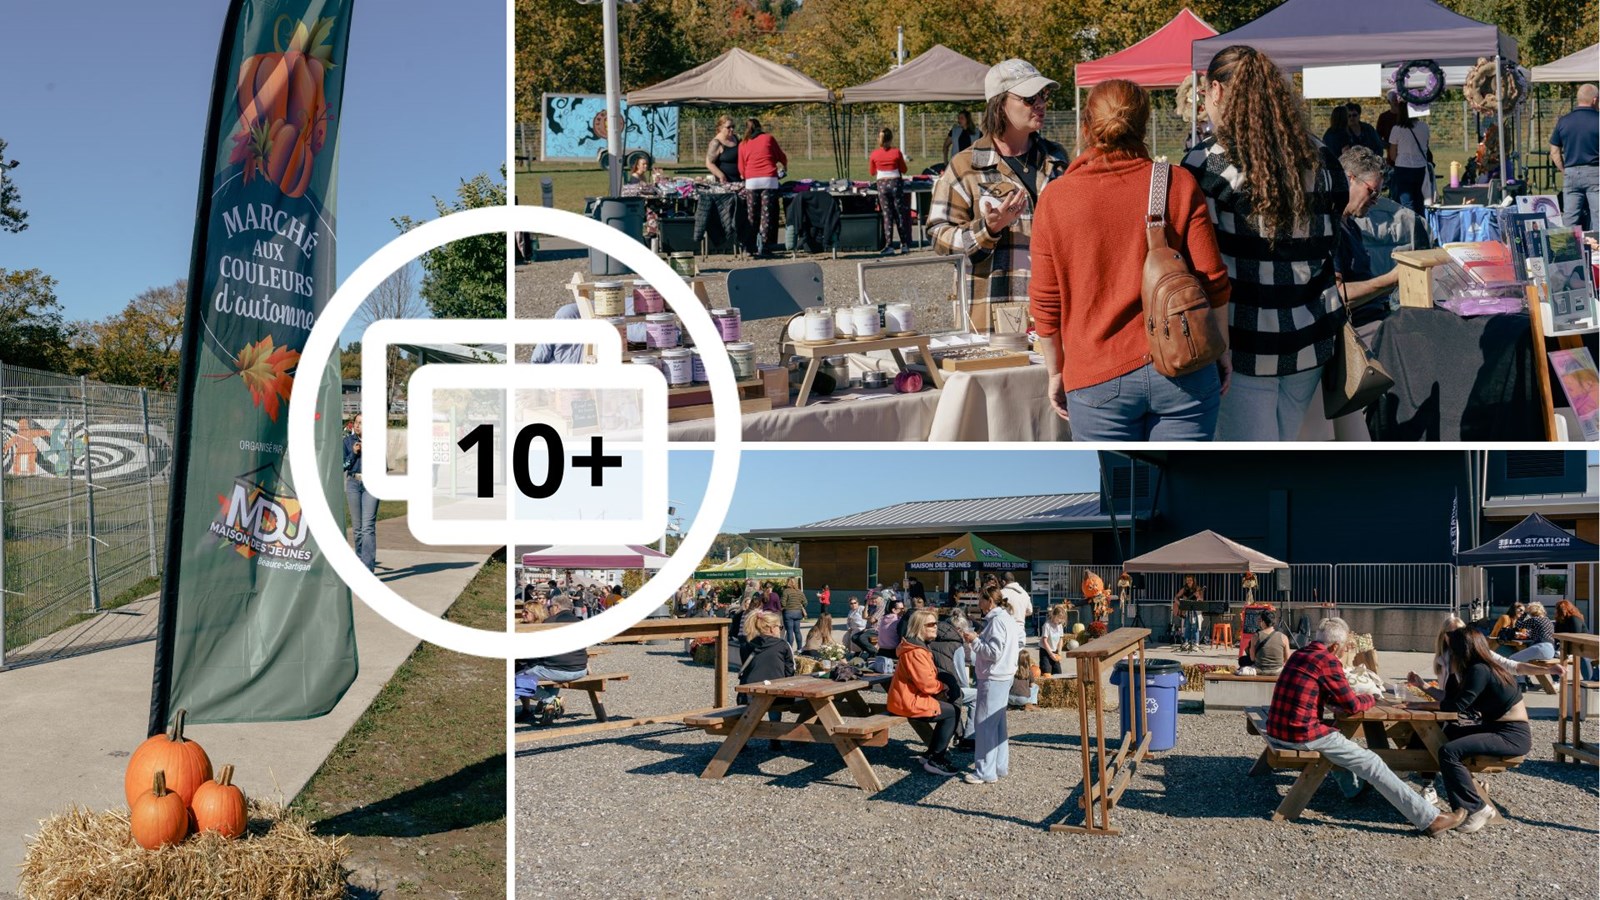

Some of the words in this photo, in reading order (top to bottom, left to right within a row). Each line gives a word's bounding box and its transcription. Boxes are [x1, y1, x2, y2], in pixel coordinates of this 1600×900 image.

[222, 203, 319, 259] MARCHÉ
[252, 239, 284, 262] AUX
[219, 255, 313, 297] COULEURS
[215, 283, 315, 331] d'automne
[240, 440, 272, 453] ORGANISÉ
[210, 521, 250, 545] MAISON
[251, 537, 267, 552] DES
[268, 545, 311, 560] JEUNES
[1524, 537, 1571, 545] STATION
[257, 557, 311, 571] Beauce-Sartigan
